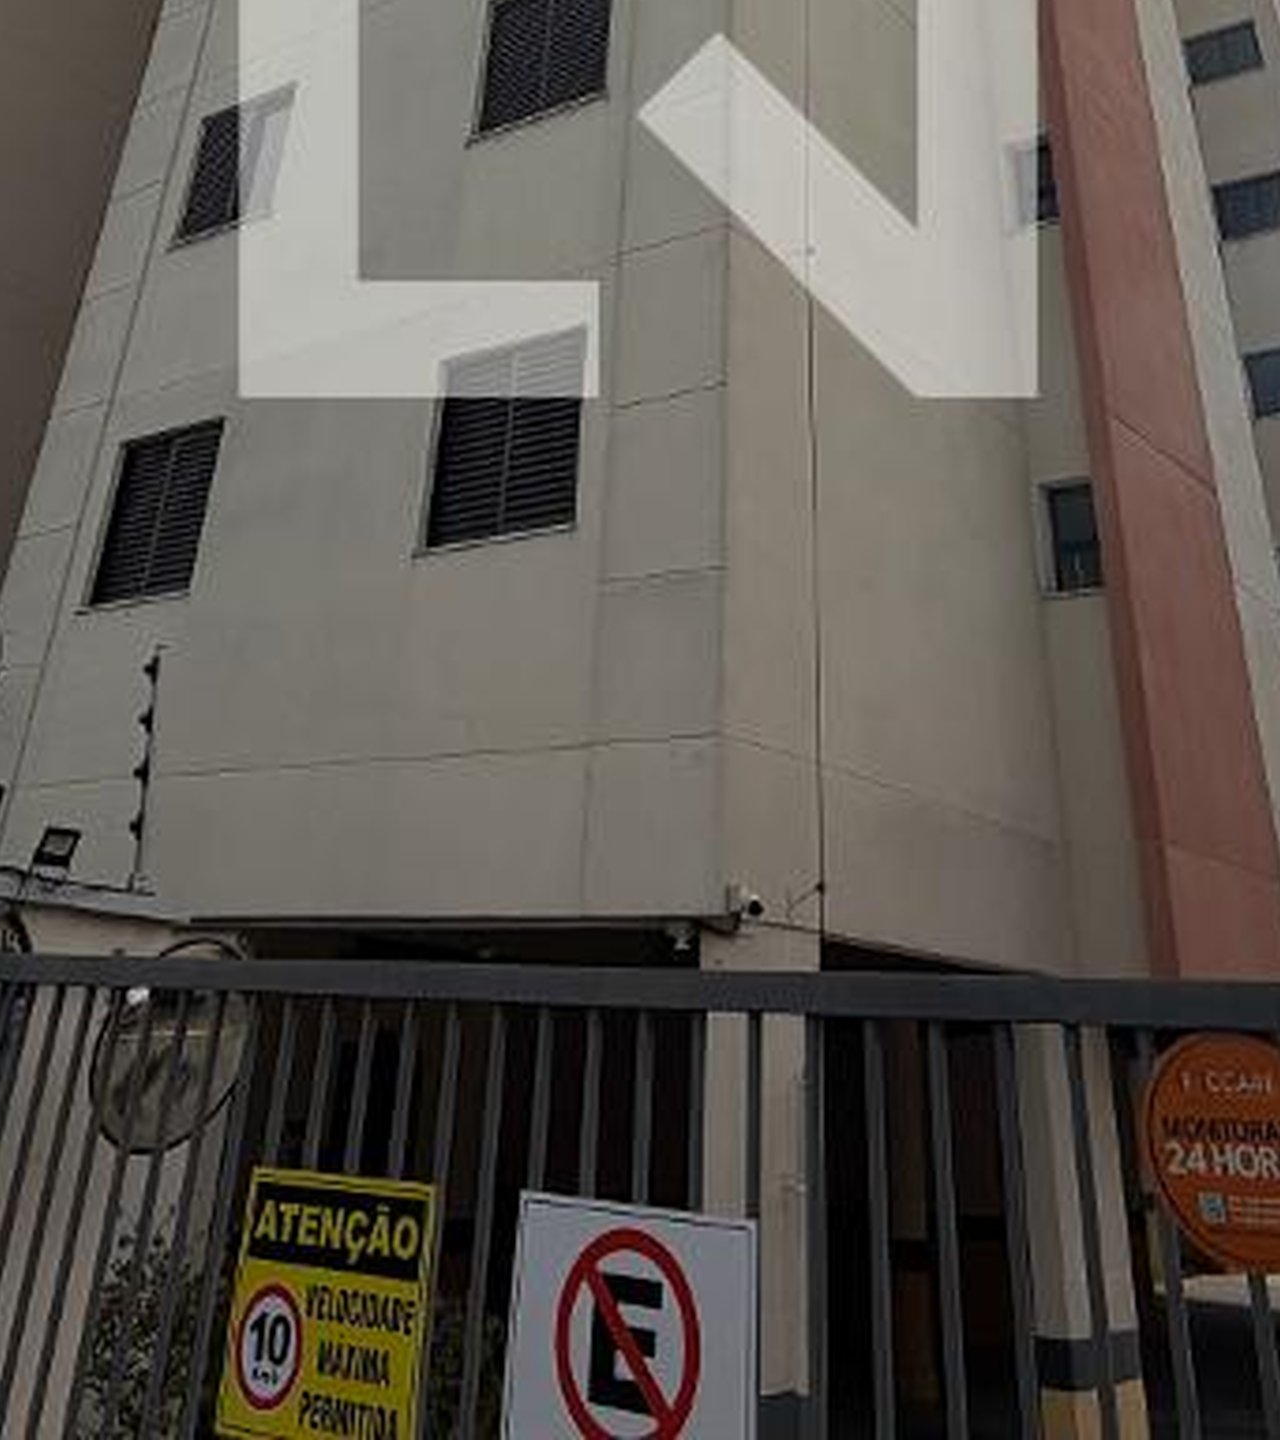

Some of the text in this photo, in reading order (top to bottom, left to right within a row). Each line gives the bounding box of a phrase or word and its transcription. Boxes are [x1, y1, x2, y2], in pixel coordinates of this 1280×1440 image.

[1164, 1139, 1207, 1176] 24
[253, 1199, 420, 1266] ATENÇÃO
[305, 1284, 416, 1337] VELOCIDADE
[250, 1312, 291, 1366] 10
[586, 1273, 665, 1416] E
